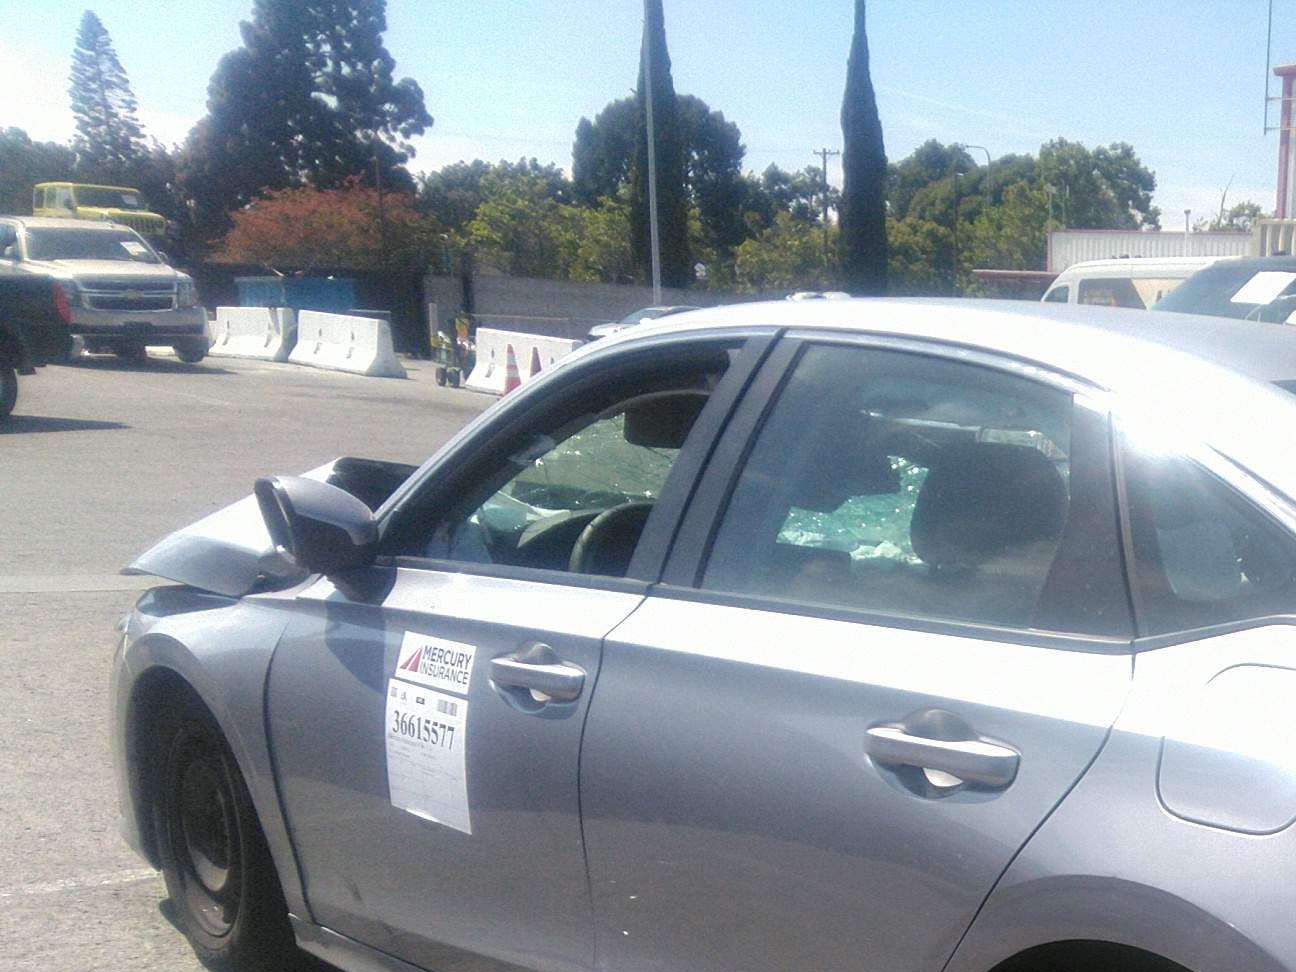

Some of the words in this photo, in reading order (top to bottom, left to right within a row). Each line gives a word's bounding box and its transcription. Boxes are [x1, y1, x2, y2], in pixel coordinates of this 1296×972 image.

[424, 645, 472, 668] MERCURY
[420, 663, 468, 685] INSURANCE
[392, 710, 455, 751] 36615577
